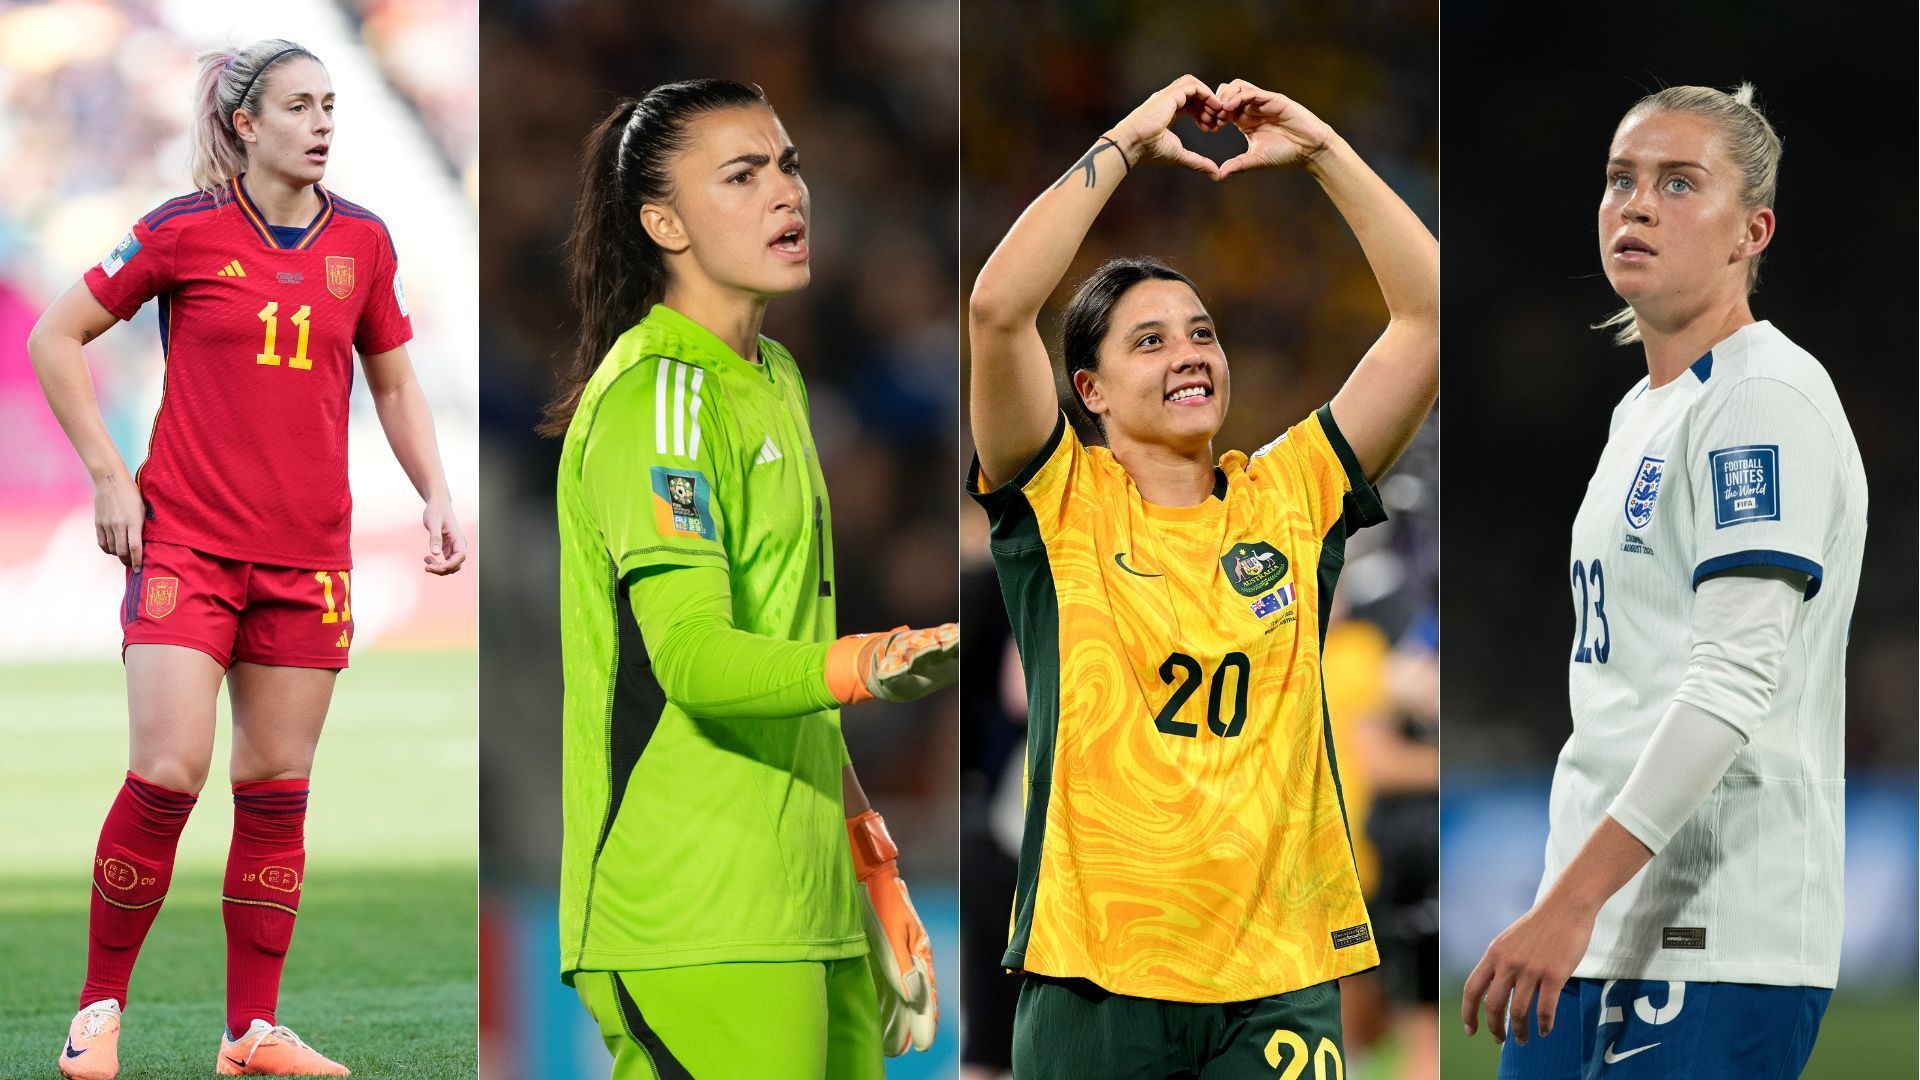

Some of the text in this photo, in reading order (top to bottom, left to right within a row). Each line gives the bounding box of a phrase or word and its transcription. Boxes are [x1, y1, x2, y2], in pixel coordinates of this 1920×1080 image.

[256, 301, 313, 371] 11
[1724, 458, 1764, 473] FOOTBALL
[1725, 469, 1764, 487] UNITES
[1724, 482, 1767, 500] the World
[1737, 500, 1753, 508] FIFA
[1243, 564, 1279, 587] AUSTRALIA
[315, 571, 350, 624] 11
[1573, 558, 1610, 664] 23
[1155, 651, 1250, 738] 20
[242, 873, 256, 882] 19
